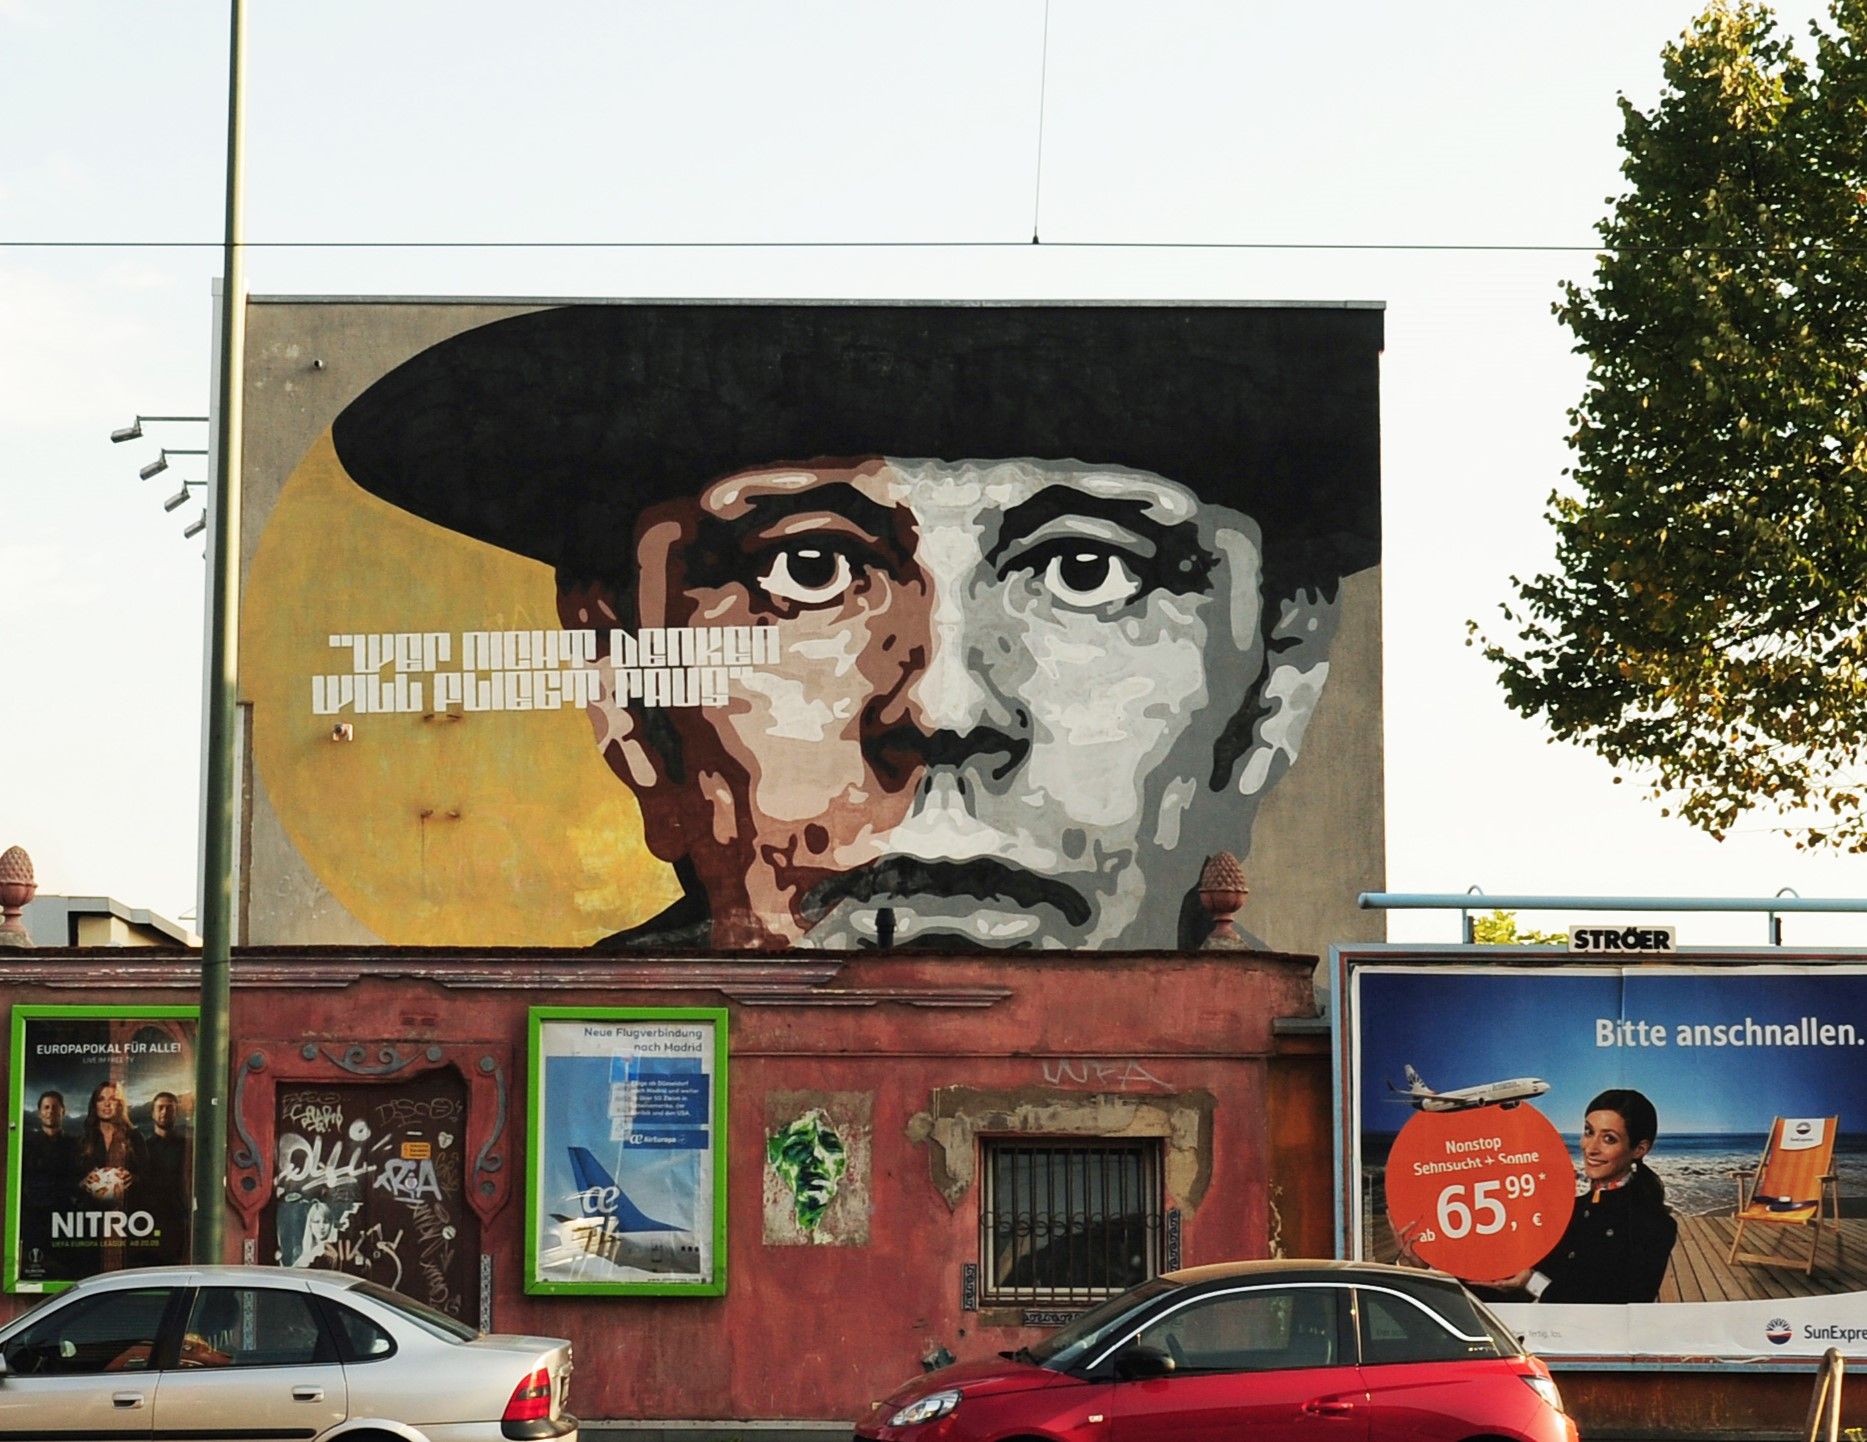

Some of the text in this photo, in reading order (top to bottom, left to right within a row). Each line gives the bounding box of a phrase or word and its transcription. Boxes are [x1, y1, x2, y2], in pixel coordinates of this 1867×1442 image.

[462, 630, 597, 670] NICHT
[610, 625, 781, 668] DENKEN
[312, 673, 423, 714] WILL
[1574, 927, 1671, 950] STRÖER
[584, 1027, 703, 1040] Neue Flugverbindung
[1595, 1017, 1865, 1047] Bitte anschnallen.
[36, 1041, 181, 1055] EUROPAPOKAL FÜR ALLE!
[634, 1042, 702, 1052] nach Madrid
[1445, 1137, 1502, 1154] Nonstop
[1413, 1157, 1483, 1176] Sehnsucht
[1498, 1151, 1540, 1164] Sonne
[1419, 1228, 1436, 1243] ab
